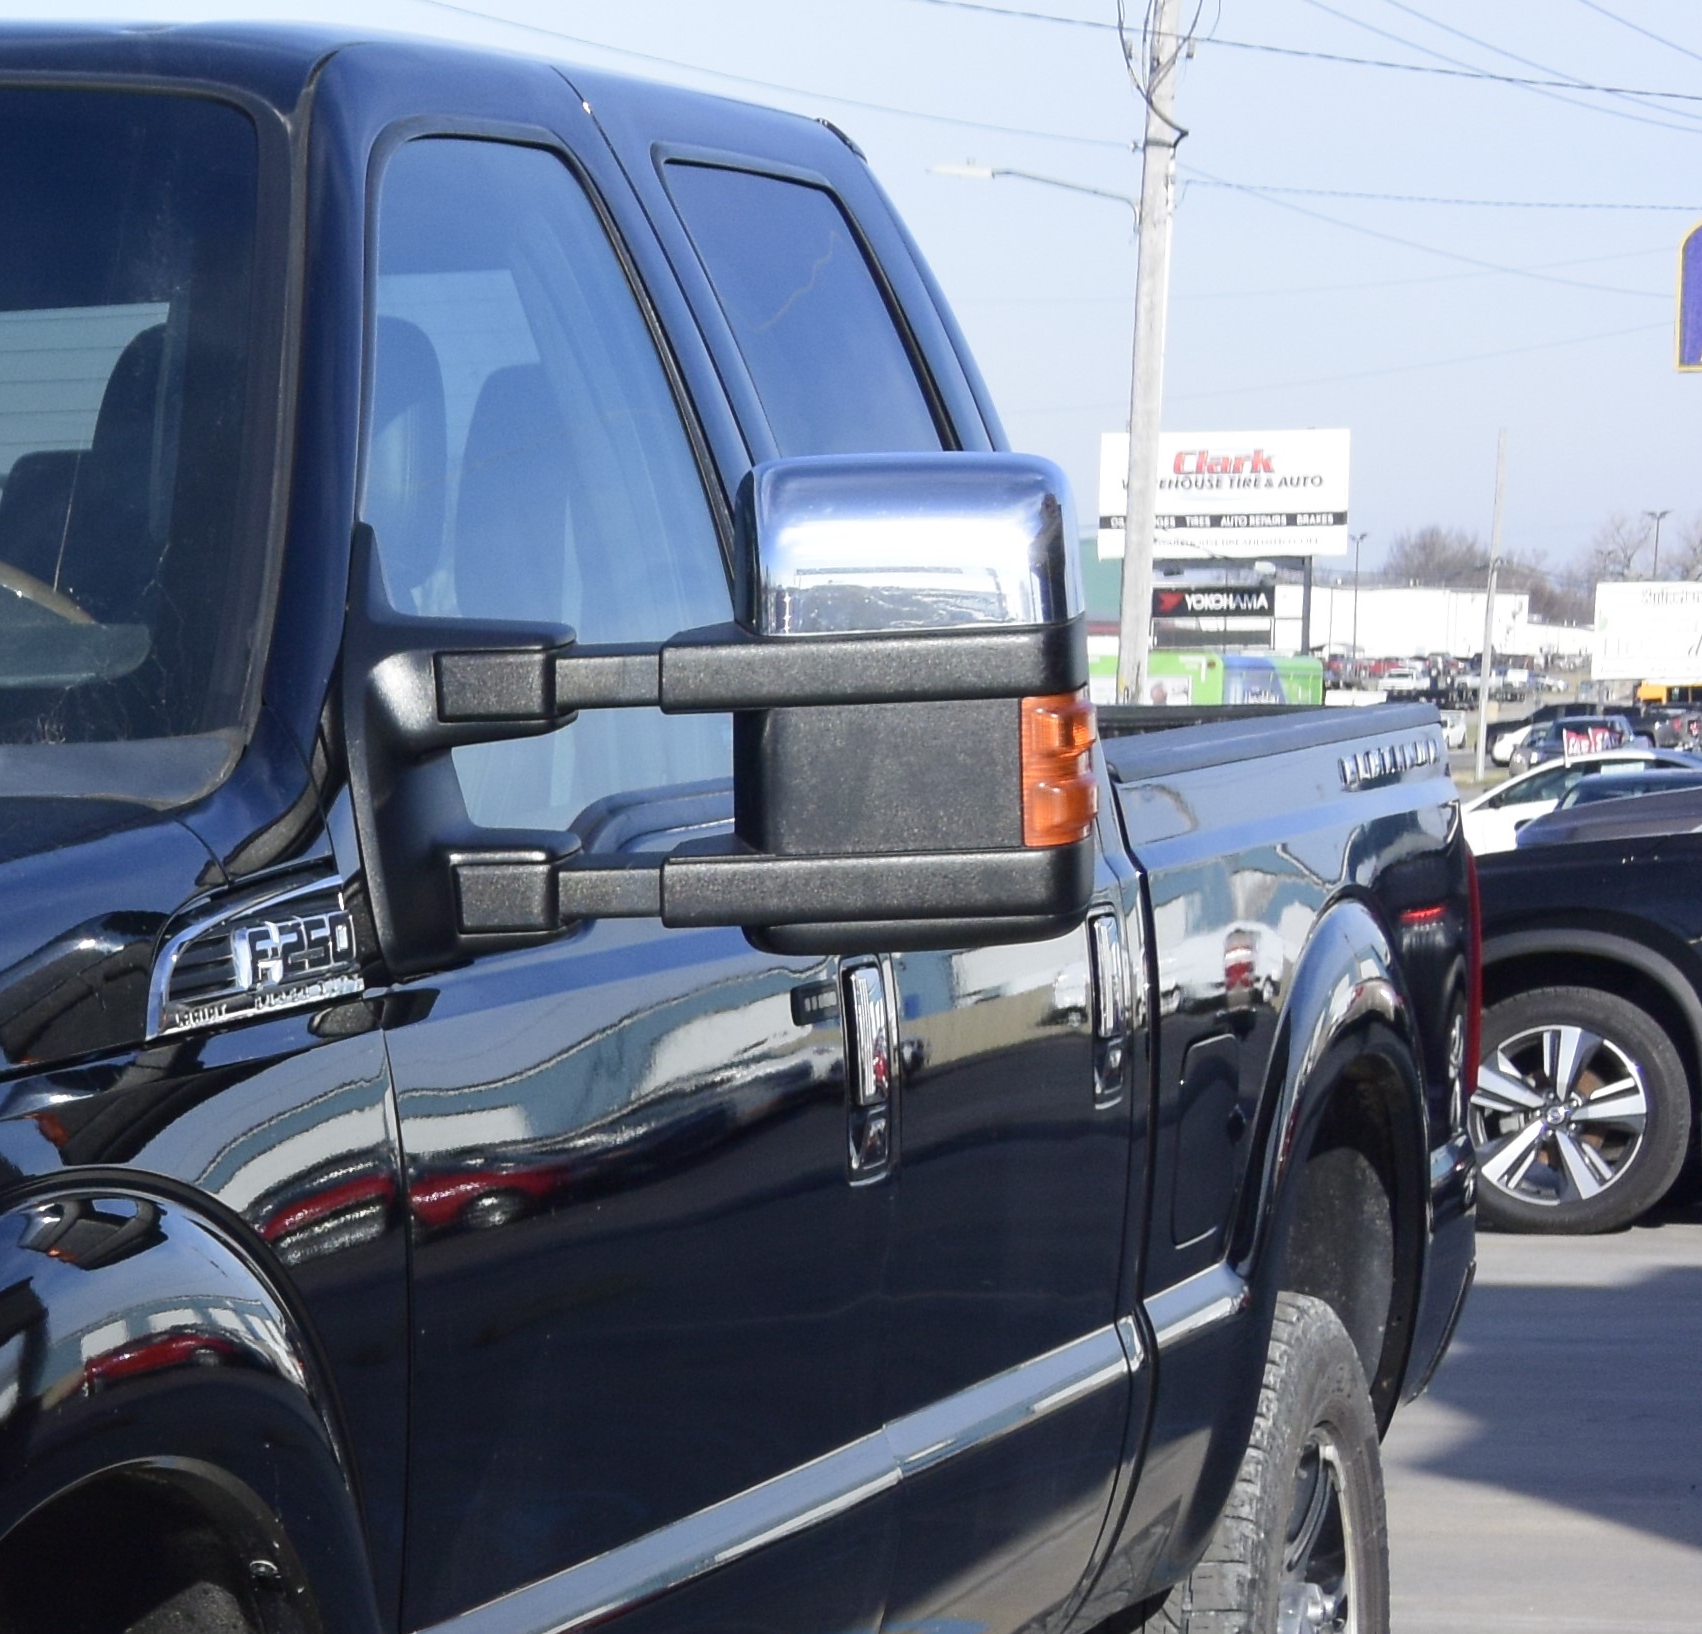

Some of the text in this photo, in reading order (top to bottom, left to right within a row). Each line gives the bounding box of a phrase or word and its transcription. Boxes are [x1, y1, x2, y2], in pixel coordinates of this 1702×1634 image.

[1173, 448, 1275, 475] Clark
[1122, 475, 1324, 491] EHOUSE TIRE & AUTO
[1220, 514, 1247, 528] AUTO
[1249, 513, 1287, 527] REPAIRS
[1296, 512, 1334, 526] BRAKES
[1184, 592, 1268, 611] YOKOHAMA
